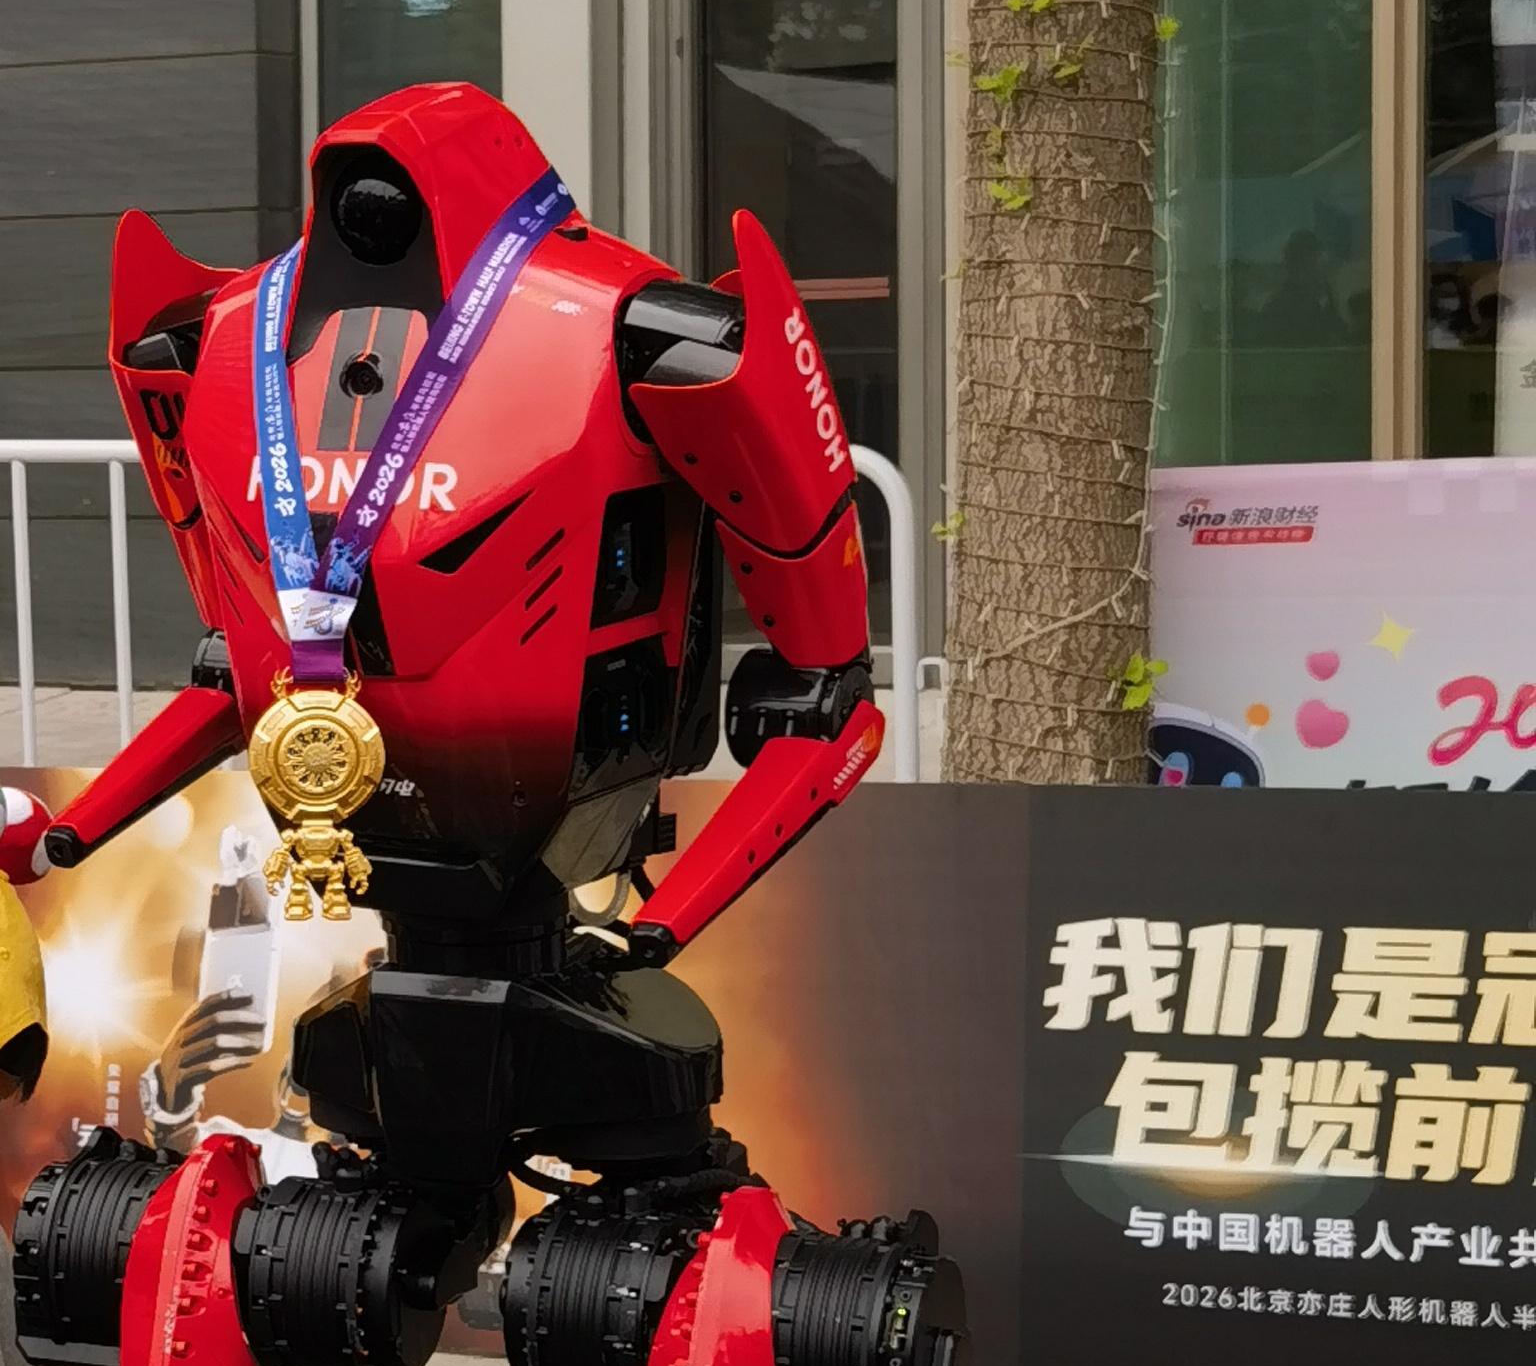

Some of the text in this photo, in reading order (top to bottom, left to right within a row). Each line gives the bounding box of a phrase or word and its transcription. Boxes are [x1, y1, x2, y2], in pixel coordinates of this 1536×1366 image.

[784, 306, 846, 472] HONOR
[268, 442, 294, 493] 2026
[368, 452, 405, 507] 2026
[1230, 505, 1319, 526] 新浪财经
[1104, 1051, 1532, 1186] 包揽前
[1124, 1206, 1536, 1270] 与中国机器人产业共
[1162, 1282, 1536, 1332] 2026北京亦庄人形机器人半
